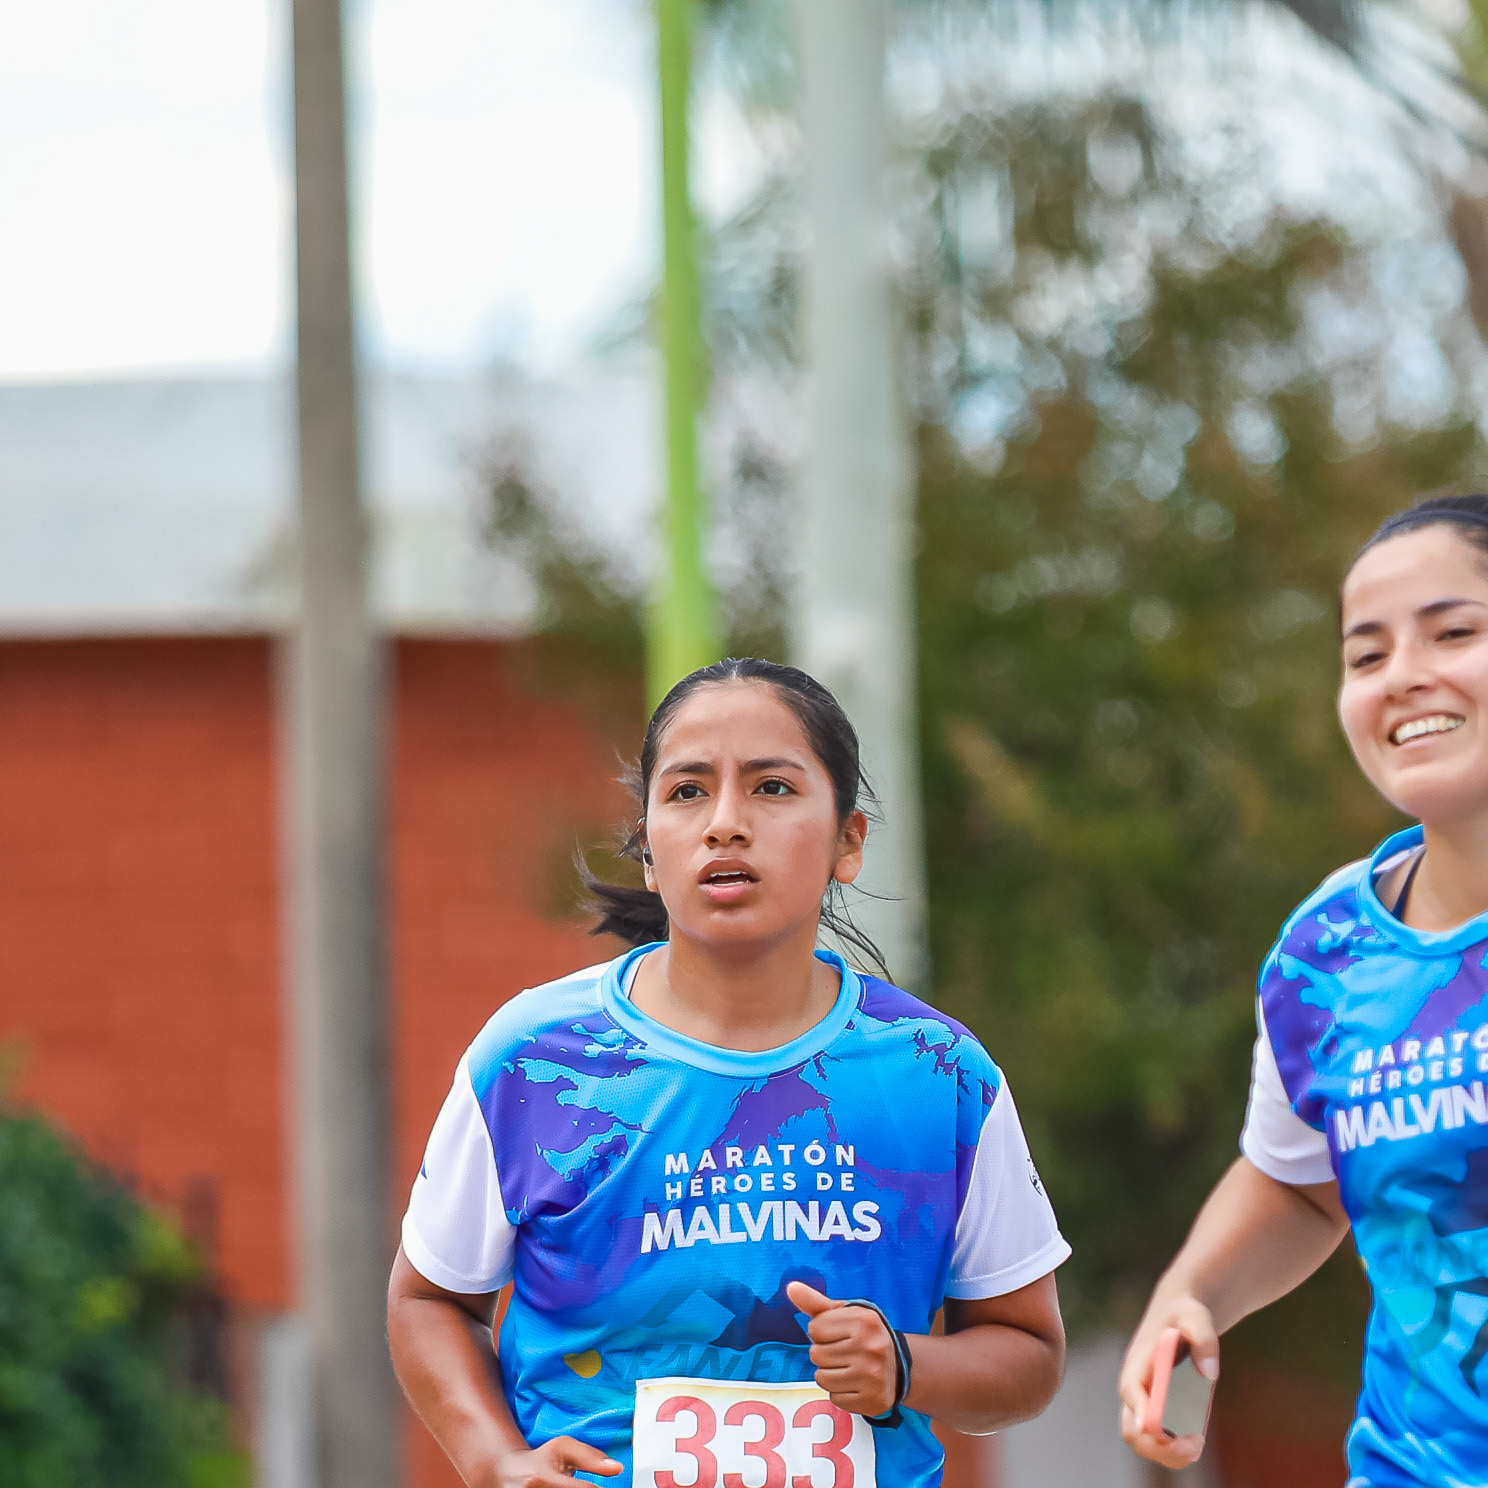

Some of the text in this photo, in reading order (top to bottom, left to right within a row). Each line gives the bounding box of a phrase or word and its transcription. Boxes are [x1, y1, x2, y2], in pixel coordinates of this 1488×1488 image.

[1349, 1057, 1464, 1098] HÉROES
[664, 1140, 855, 1176] MARATÓN
[665, 1172, 855, 1200] HÉROES DE
[640, 1200, 882, 1254] MALVINAS
